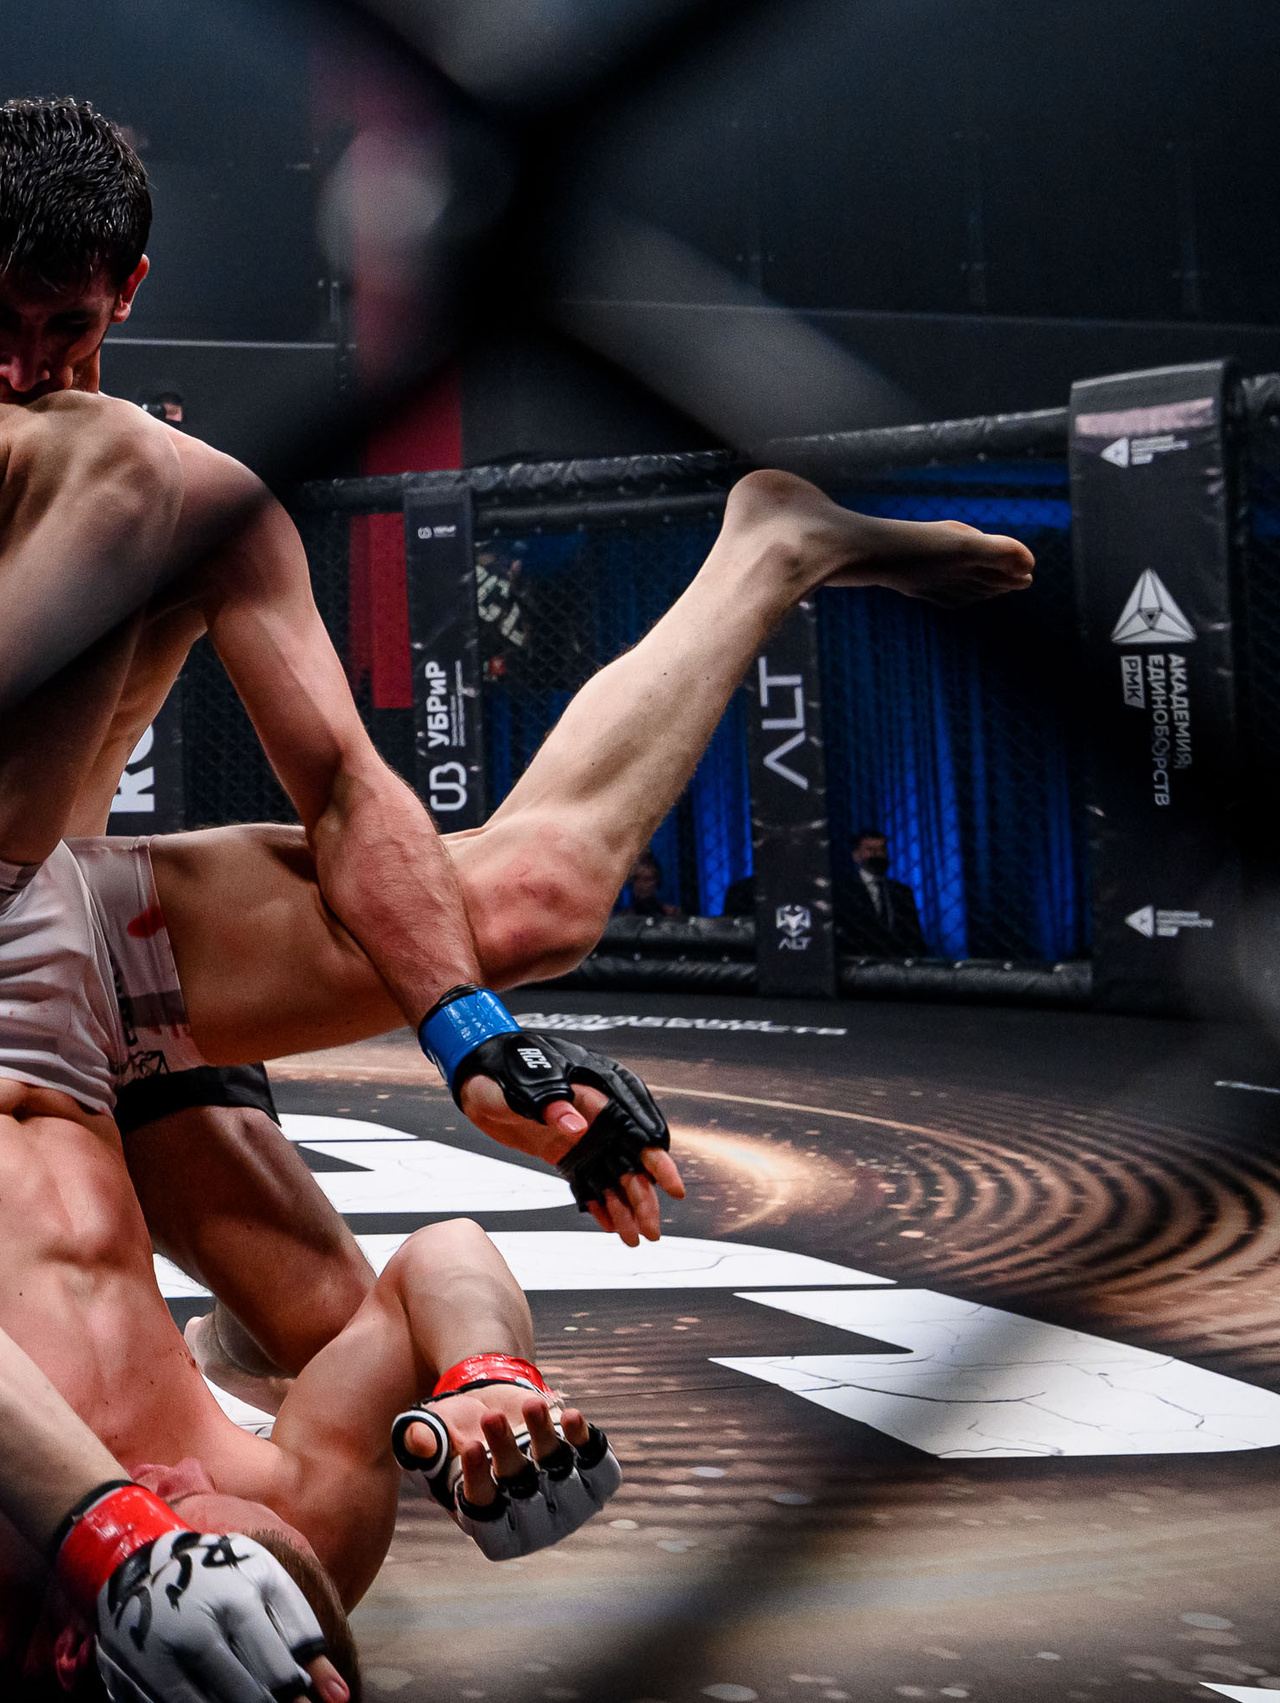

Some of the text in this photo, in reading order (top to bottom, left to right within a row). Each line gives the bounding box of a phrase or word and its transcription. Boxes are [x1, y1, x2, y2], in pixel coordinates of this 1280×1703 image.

[1123, 657, 1143, 701] РМК
[424, 660, 450, 748] УБРиР
[517, 1047, 552, 1069] RCC
